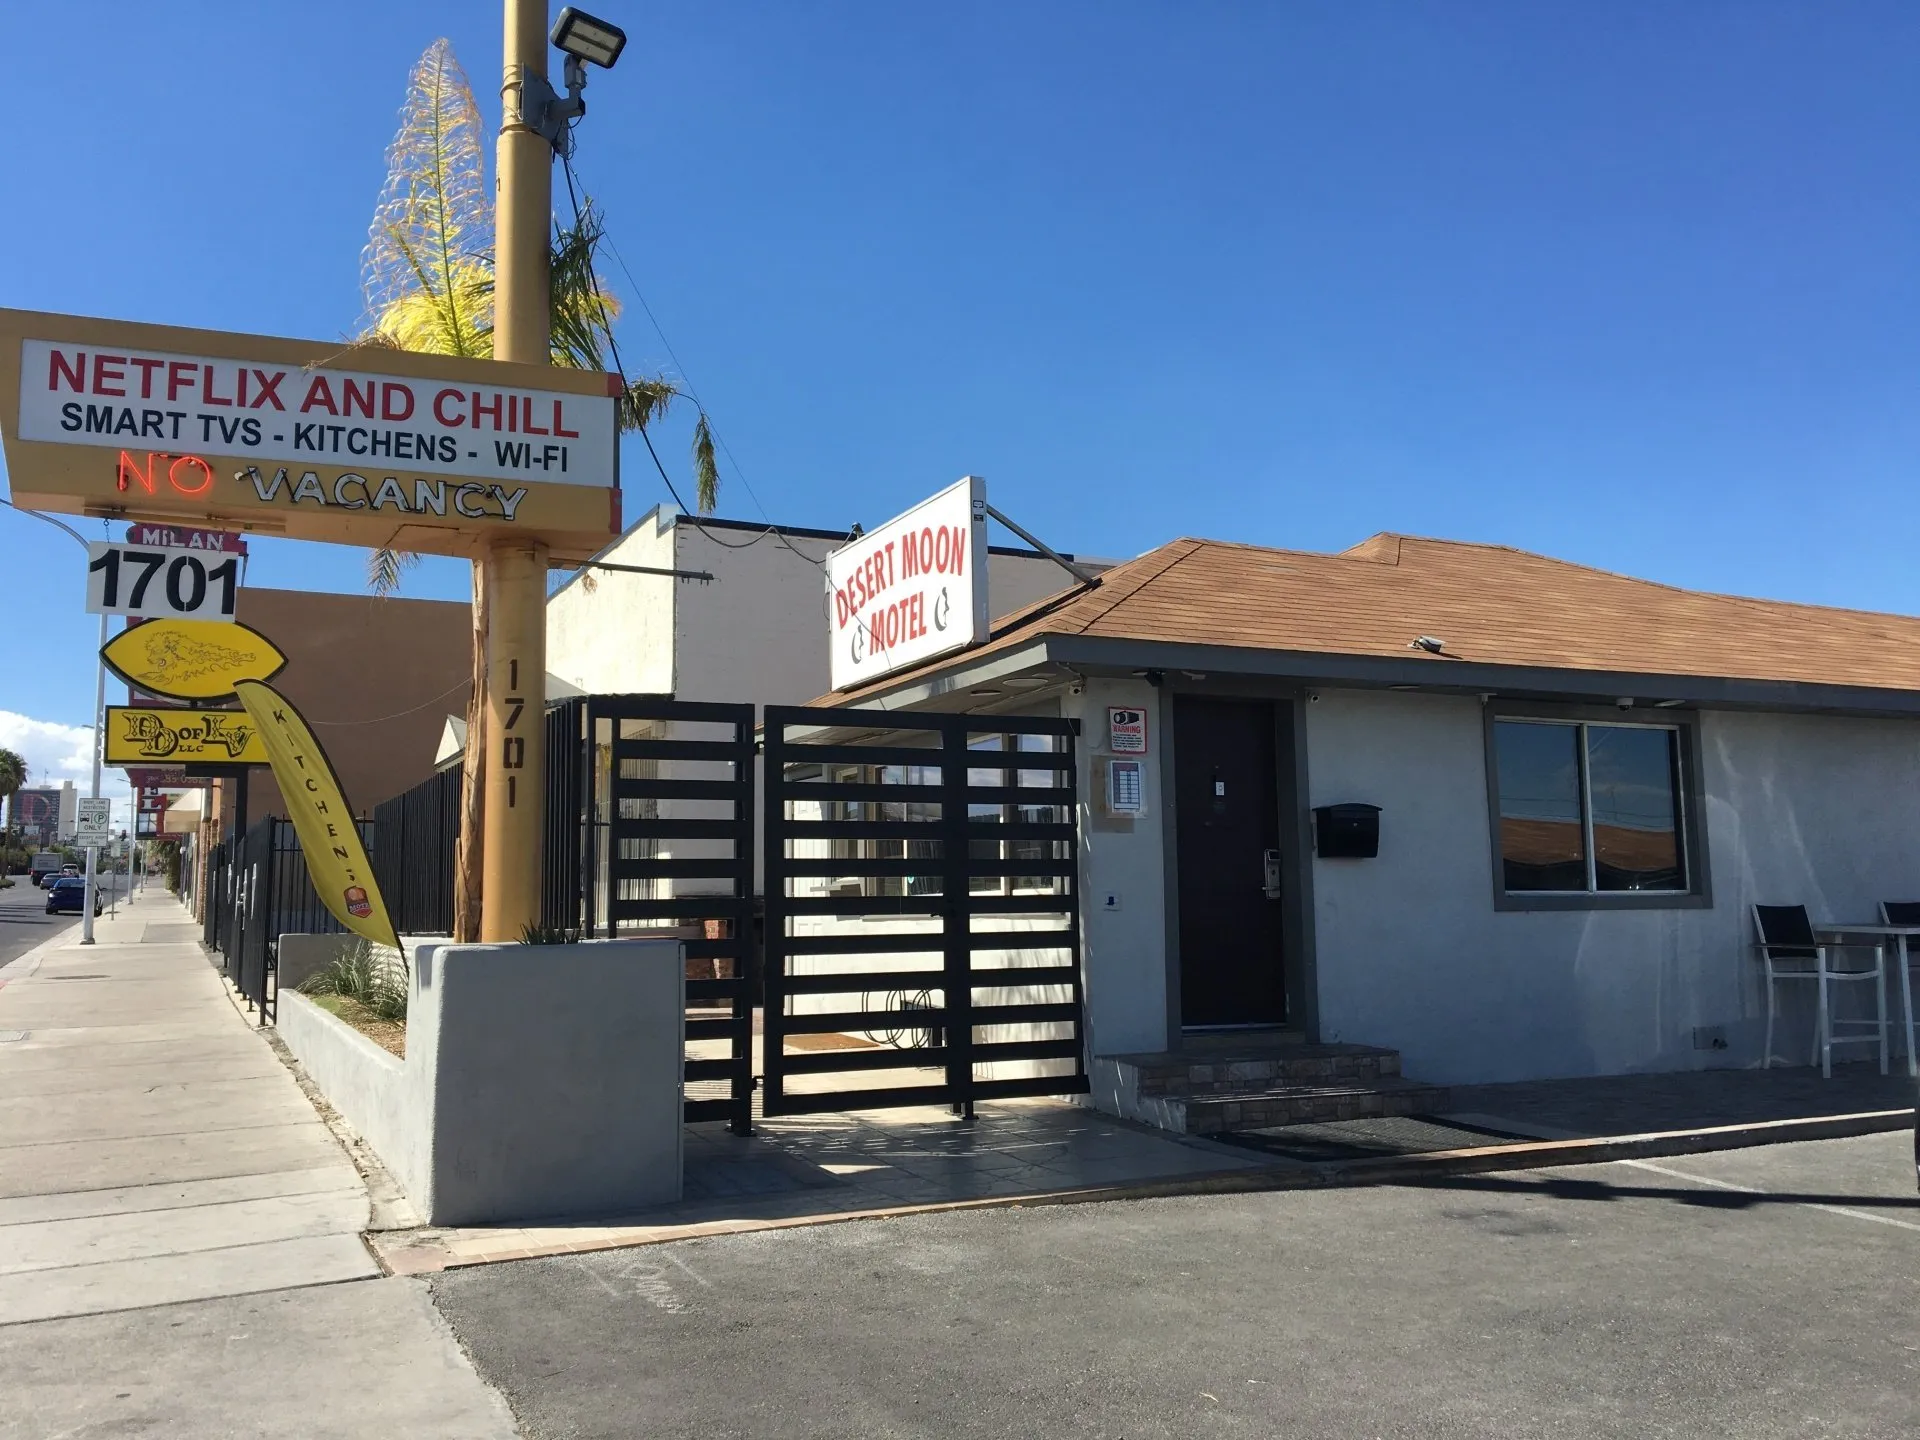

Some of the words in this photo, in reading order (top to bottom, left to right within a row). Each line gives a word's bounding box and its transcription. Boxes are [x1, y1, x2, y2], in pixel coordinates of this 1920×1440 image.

[48, 349, 286, 412] NETFLIX
[301, 374, 415, 422] AND
[432, 388, 580, 439] CHILL
[60, 402, 187, 440] SMART
[197, 414, 262, 446] TVS
[293, 424, 457, 464] KITCHENS
[494, 440, 568, 473] WI-FI
[117, 450, 212, 493] NO
[247, 466, 528, 521] VACANCY
[142, 527, 224, 551] MILAN
[90, 548, 237, 615] 1701
[835, 541, 895, 630] DESERT
[902, 525, 966, 580] MOON
[869, 591, 927, 656] MOTEL
[178, 727, 204, 740] OF
[179, 744, 205, 753] LLC
[503, 659, 525, 808] 1701
